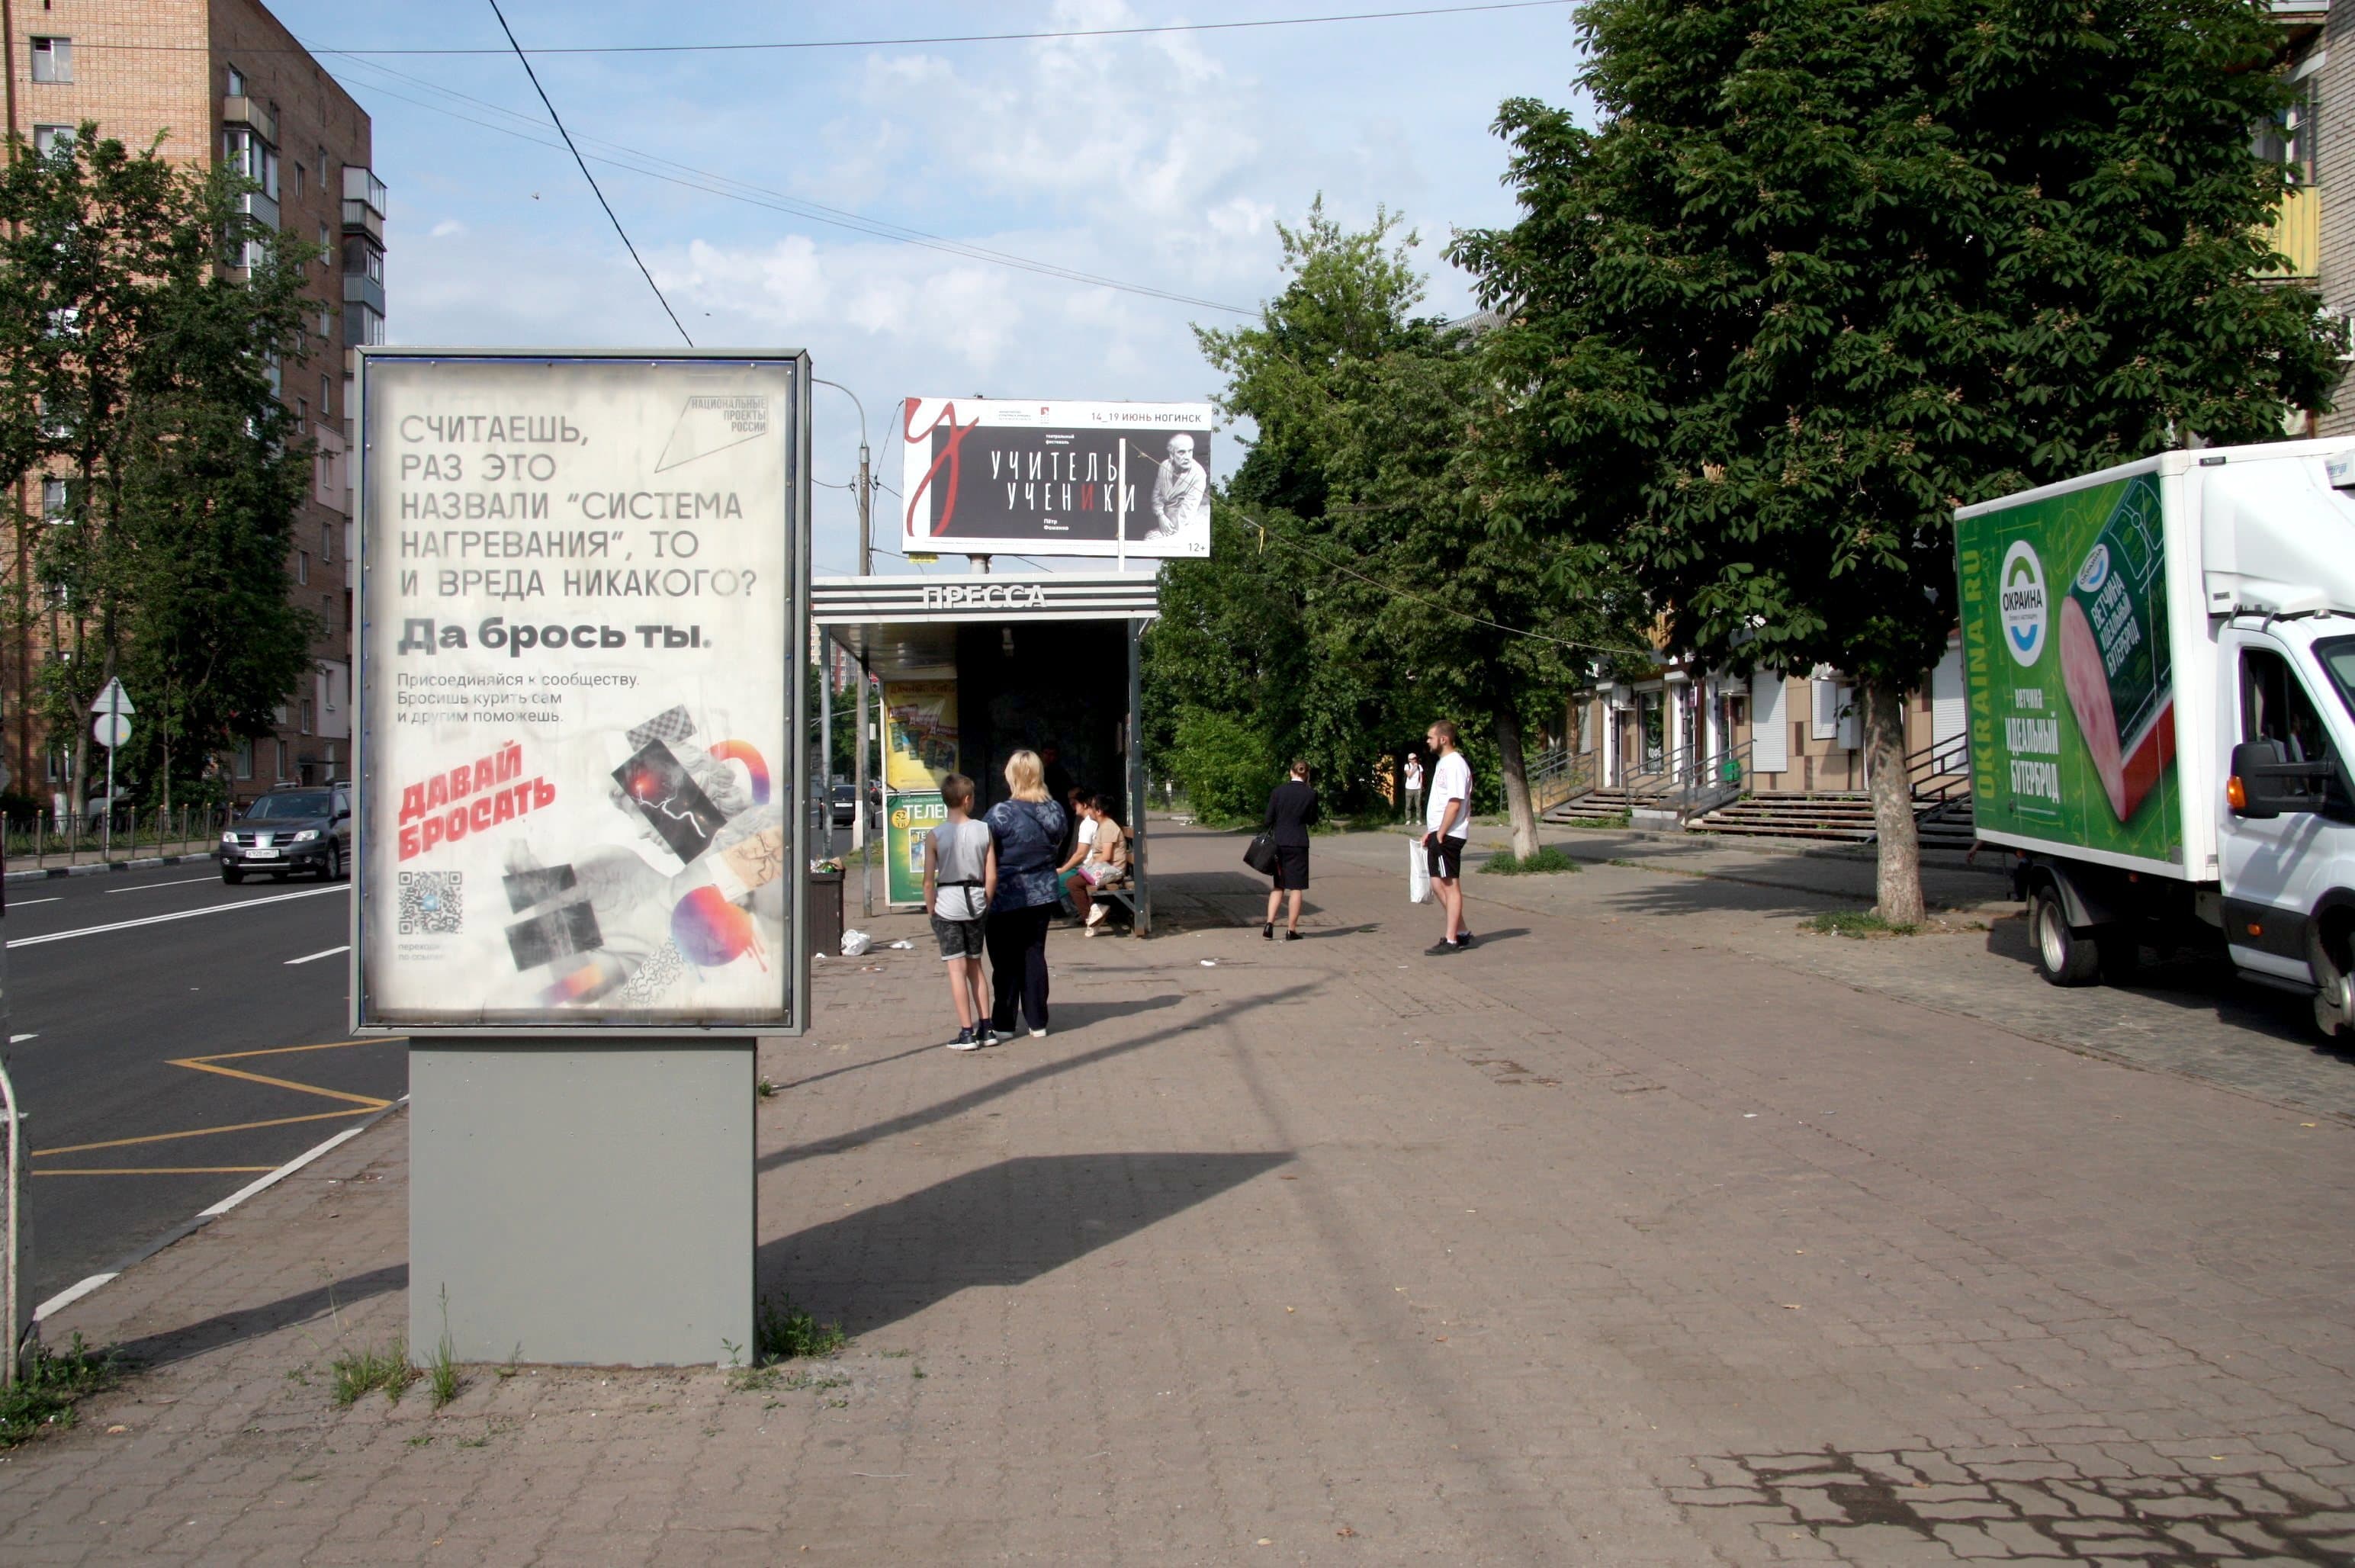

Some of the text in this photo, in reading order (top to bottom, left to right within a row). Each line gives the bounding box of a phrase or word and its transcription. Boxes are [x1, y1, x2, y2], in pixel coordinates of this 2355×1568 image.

[692, 398, 766, 410] НАЦИОНАЛЬНЫЕ
[724, 410, 766, 421] ПРОЕКТЫ
[1122, 413, 1152, 422] ИЮНЬ
[1155, 413, 1202, 423] НОГИНСК
[399, 414, 590, 447] СЧИТАЕШЬ,
[731, 421, 766, 432] РОССИИ
[400, 453, 557, 482] РАЗ ЭТО
[991, 450, 1118, 482] УЧИТЕЛЬ
[400, 492, 550, 520] НАЗВАЛИ
[1007, 482, 1136, 512] УЧЕНИКИ
[650, 530, 699, 558] ТО
[1187, 541, 1206, 553] 12+
[401, 568, 758, 602] И ВРЕДА НИКАКОГО?
[923, 584, 1047, 609] ПРЕССА
[2003, 588, 2043, 612] ОКРАИНА
[2090, 570, 2125, 630] ВЕТЧИНА
[397, 616, 713, 658] Да брось ты.
[2106, 615, 2141, 677] БУТЕРБРОД
[397, 672, 640, 689] Присоединяйся к сообществу.
[1962, 549, 1995, 799] OKRAINA.RU
[397, 691, 562, 708] Бросишь курить сам
[2015, 689, 2043, 709] ветчина
[397, 712, 564, 725] и другим поможешь.
[2005, 711, 2059, 756] ИДЕАЛЬНЫЙ
[399, 738, 522, 827] ДАВАЙ
[2010, 760, 2060, 804] БУТЕРБРОД
[399, 775, 557, 863] БРОСАТЬ
